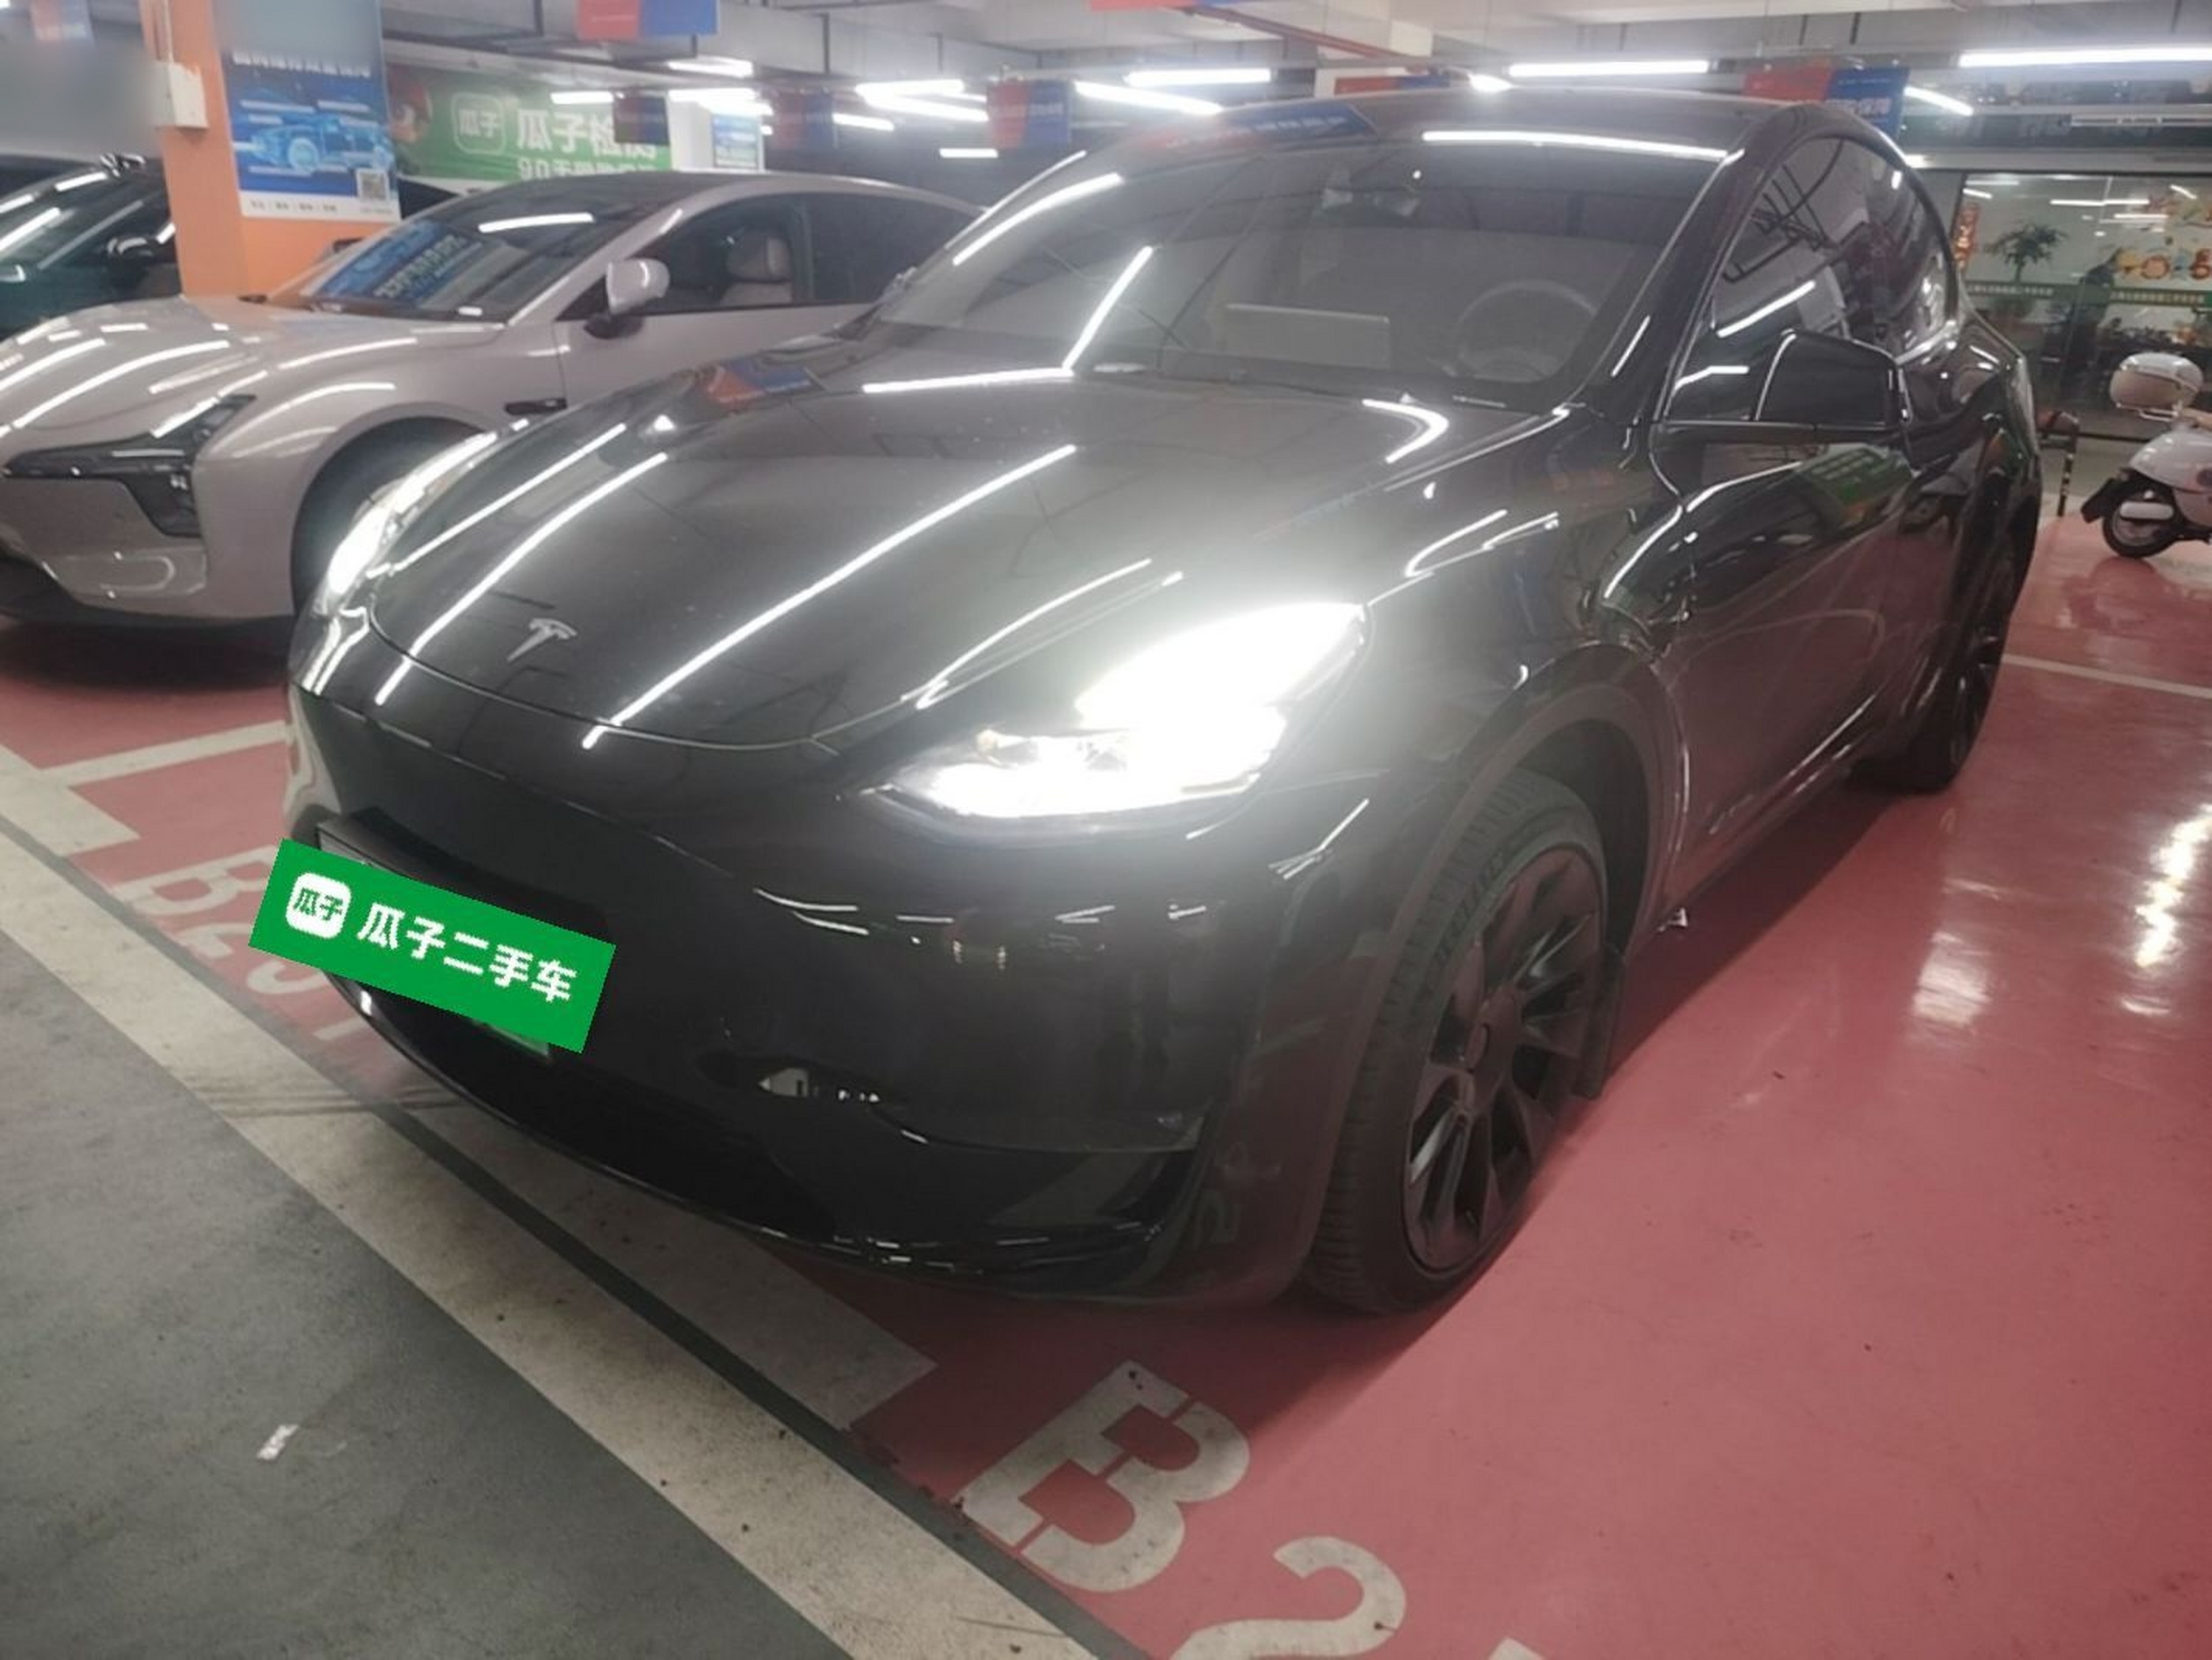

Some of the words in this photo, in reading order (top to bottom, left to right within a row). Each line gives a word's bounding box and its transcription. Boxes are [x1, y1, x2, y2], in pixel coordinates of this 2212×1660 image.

[459, 109, 499, 138] 瓜子
[517, 108, 657, 160] 瓜子检
[955, 1360, 1545, 1660] B2
